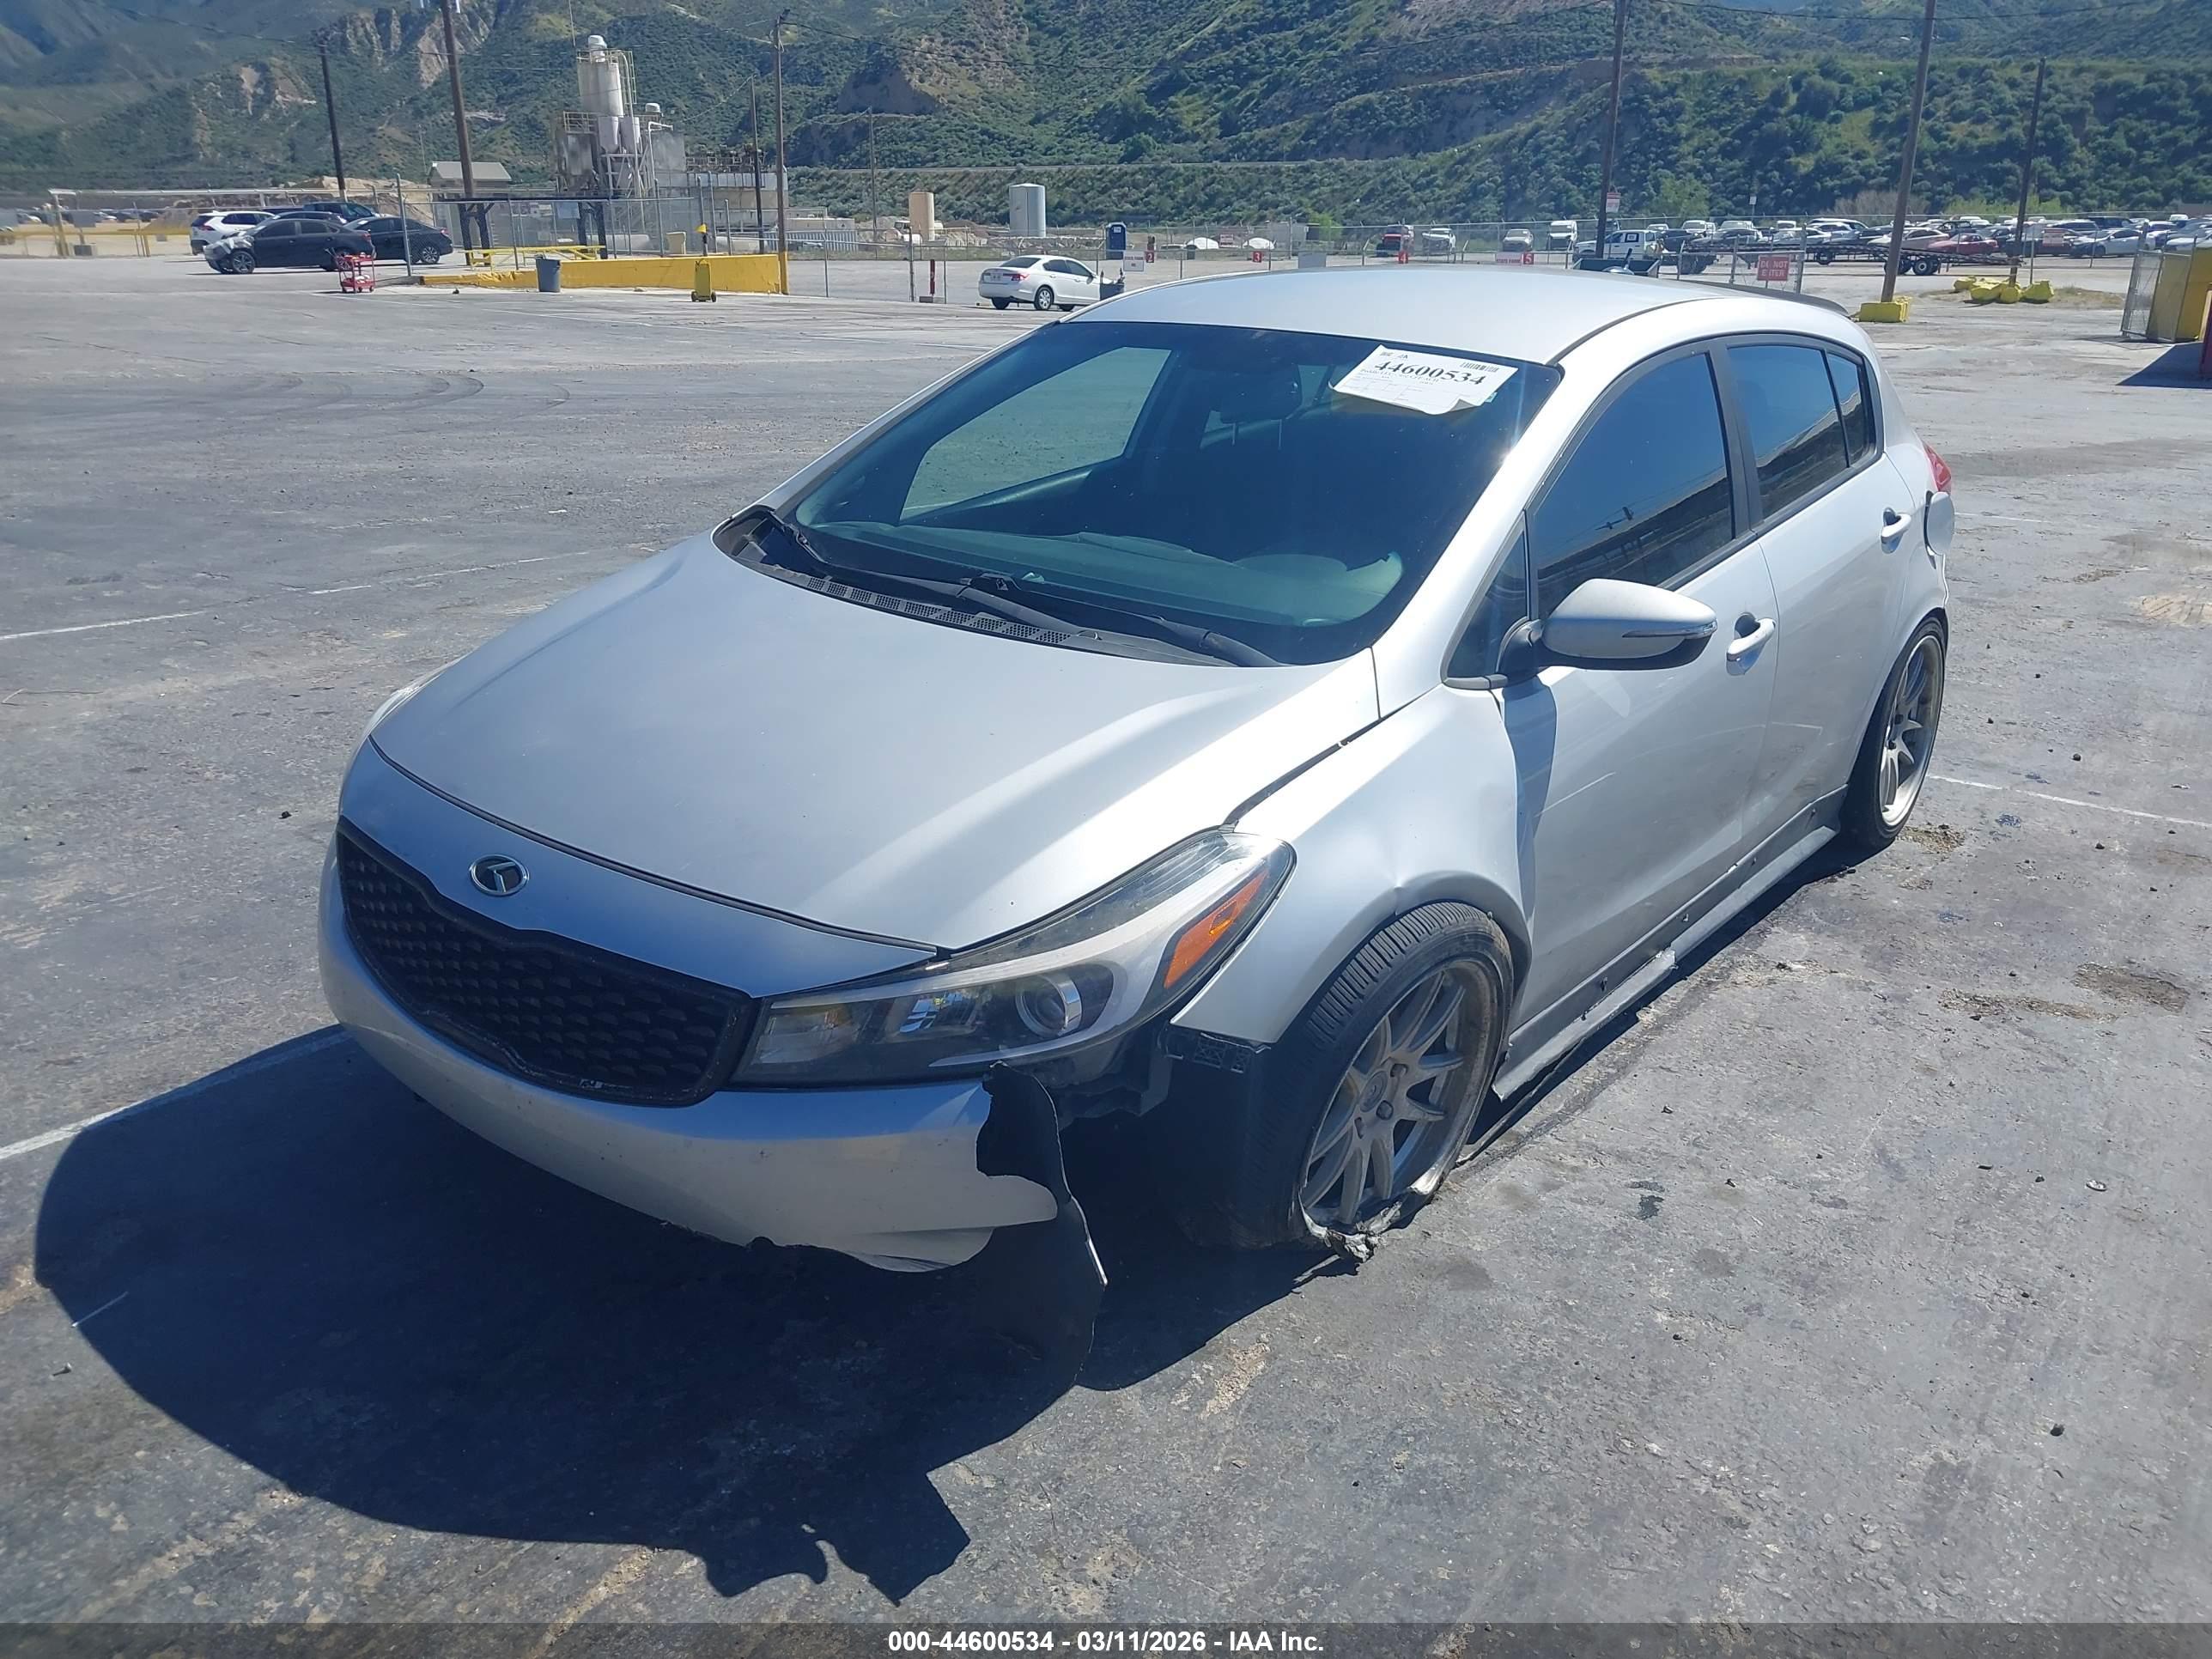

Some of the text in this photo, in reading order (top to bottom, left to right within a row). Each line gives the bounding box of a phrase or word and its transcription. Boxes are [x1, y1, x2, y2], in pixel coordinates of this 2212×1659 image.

[1147, 252, 1153, 262] 2
[1255, 252, 1260, 262] 3
[1400, 252, 1407, 263] 4
[1525, 253, 1532, 264] 5
[1773, 260, 1788, 269] NOT
[1374, 360, 1486, 386] 44600534
